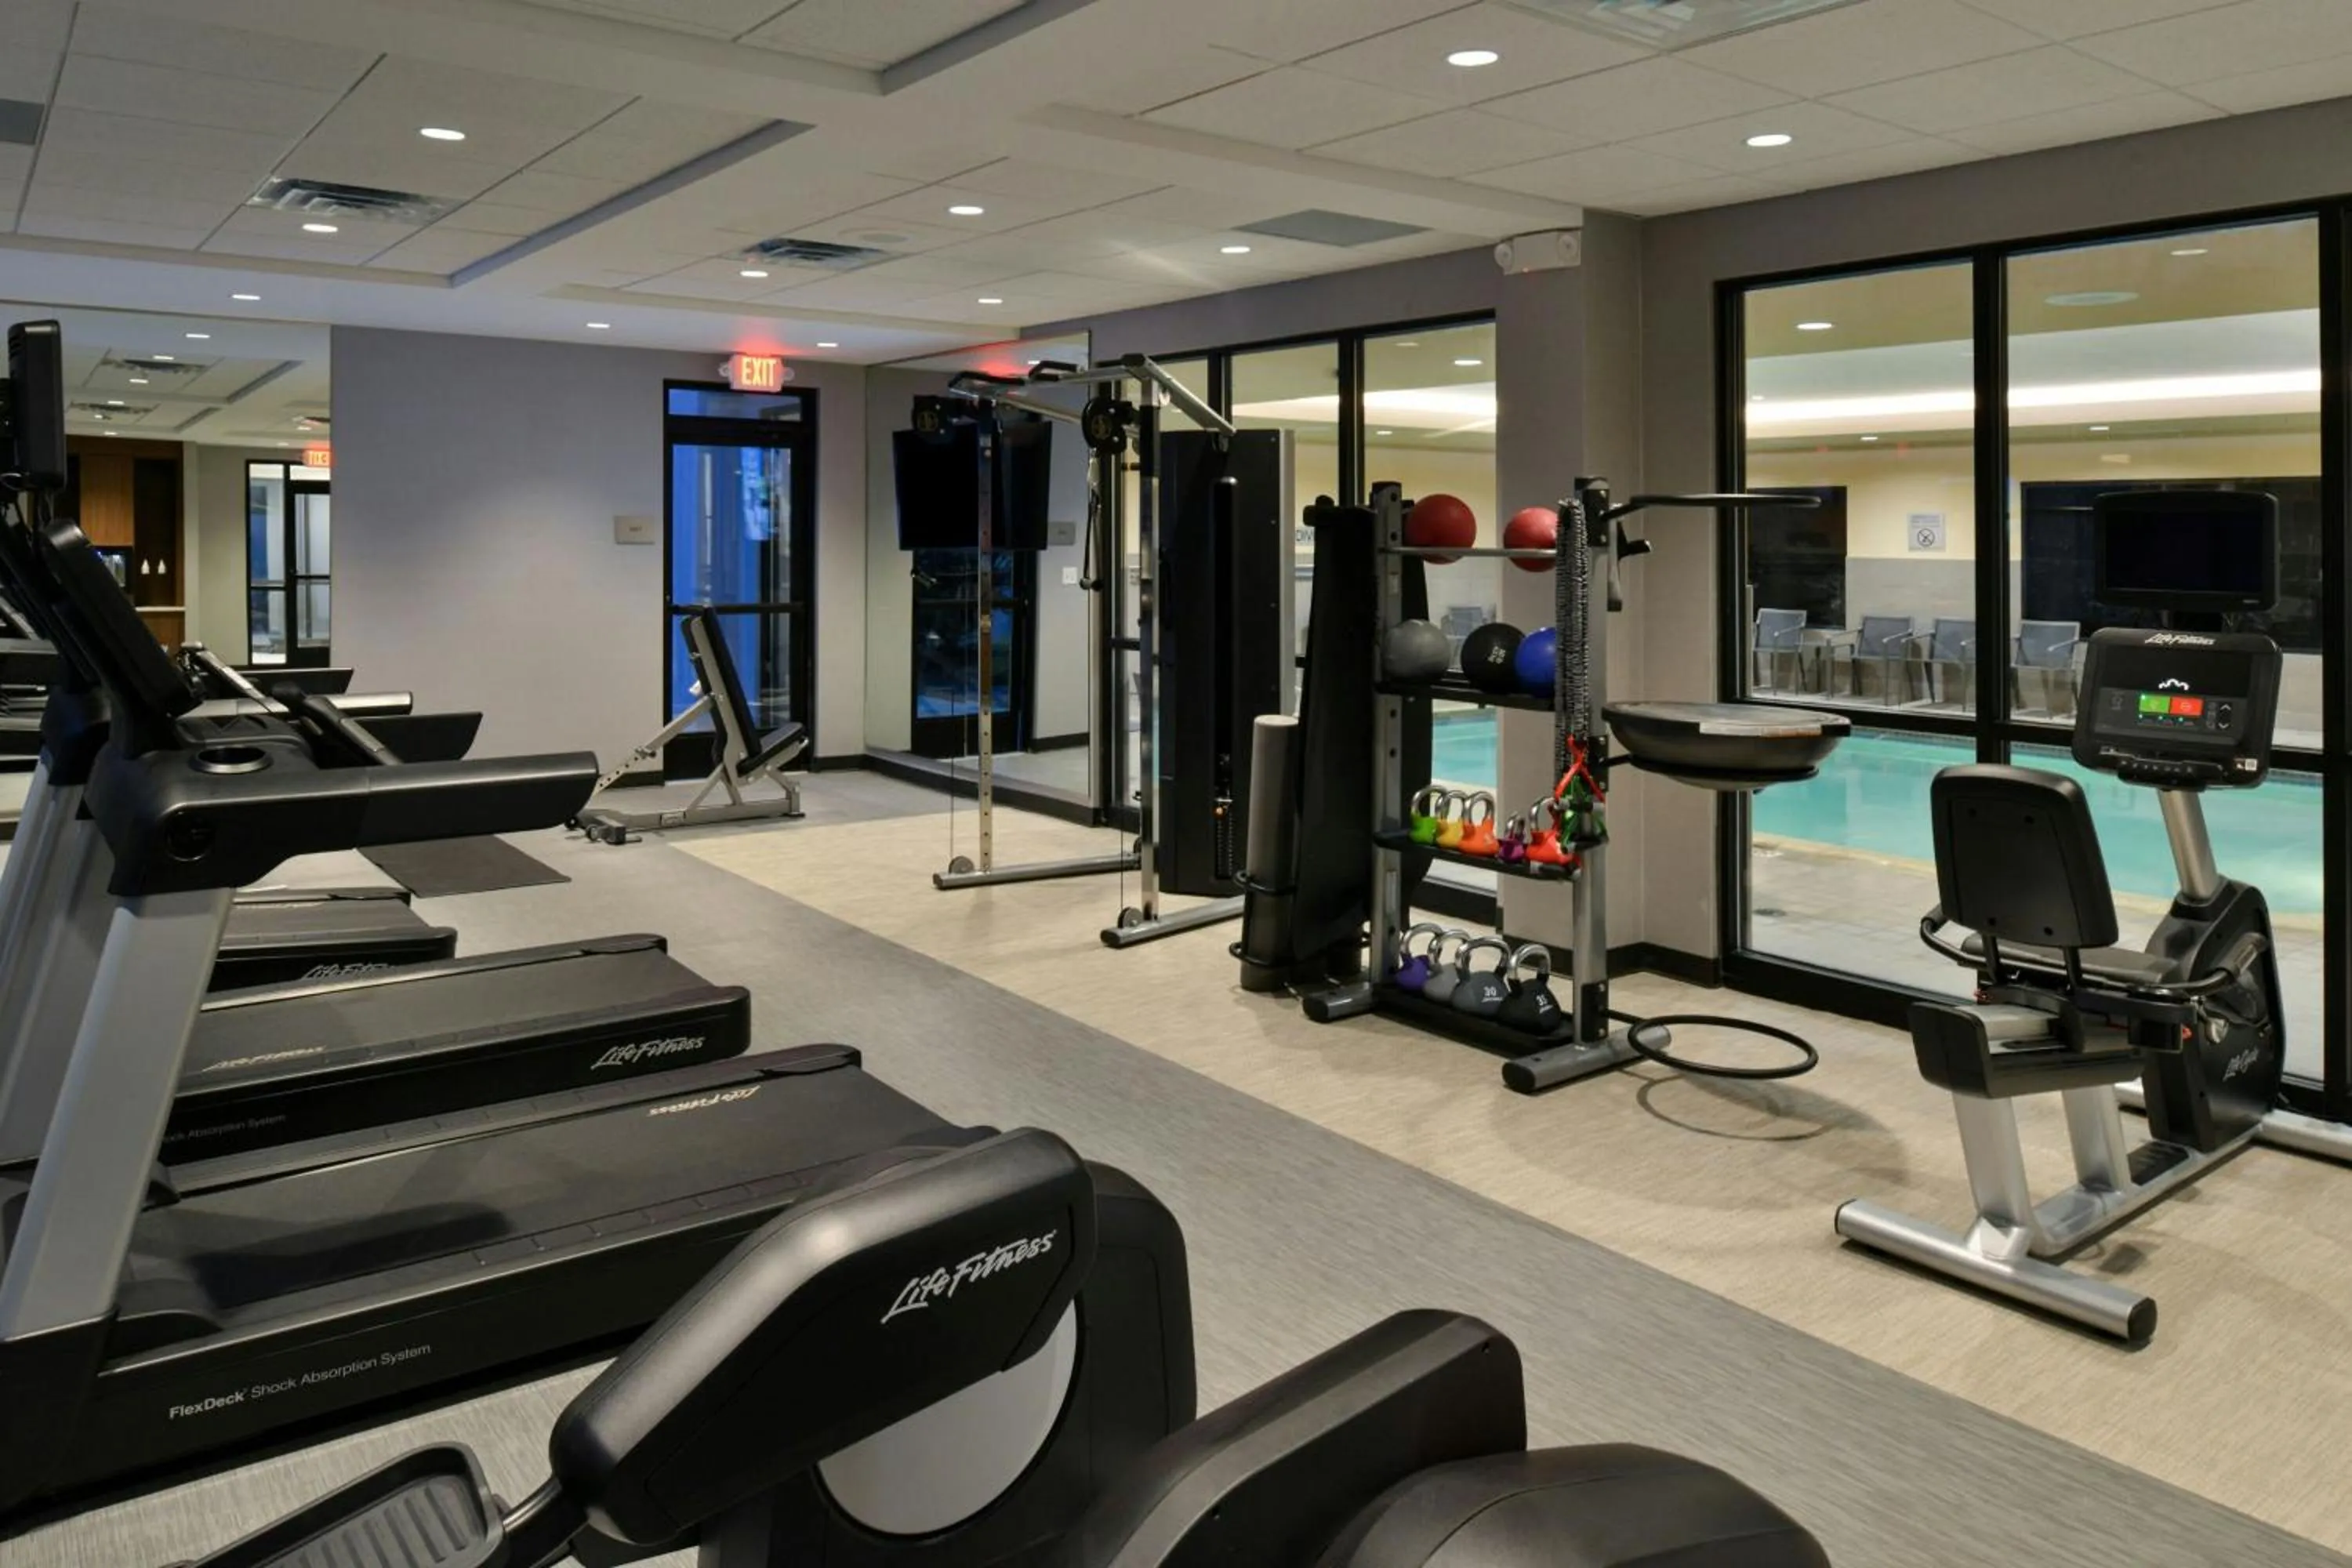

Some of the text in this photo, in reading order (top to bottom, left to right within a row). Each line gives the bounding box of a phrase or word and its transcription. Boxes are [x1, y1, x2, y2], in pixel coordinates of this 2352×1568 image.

[741, 356, 777, 387] EXIT
[880, 1229, 1057, 1324] Life Fitness
[169, 1344, 431, 1420] FlexDeck Shock Absorption System
